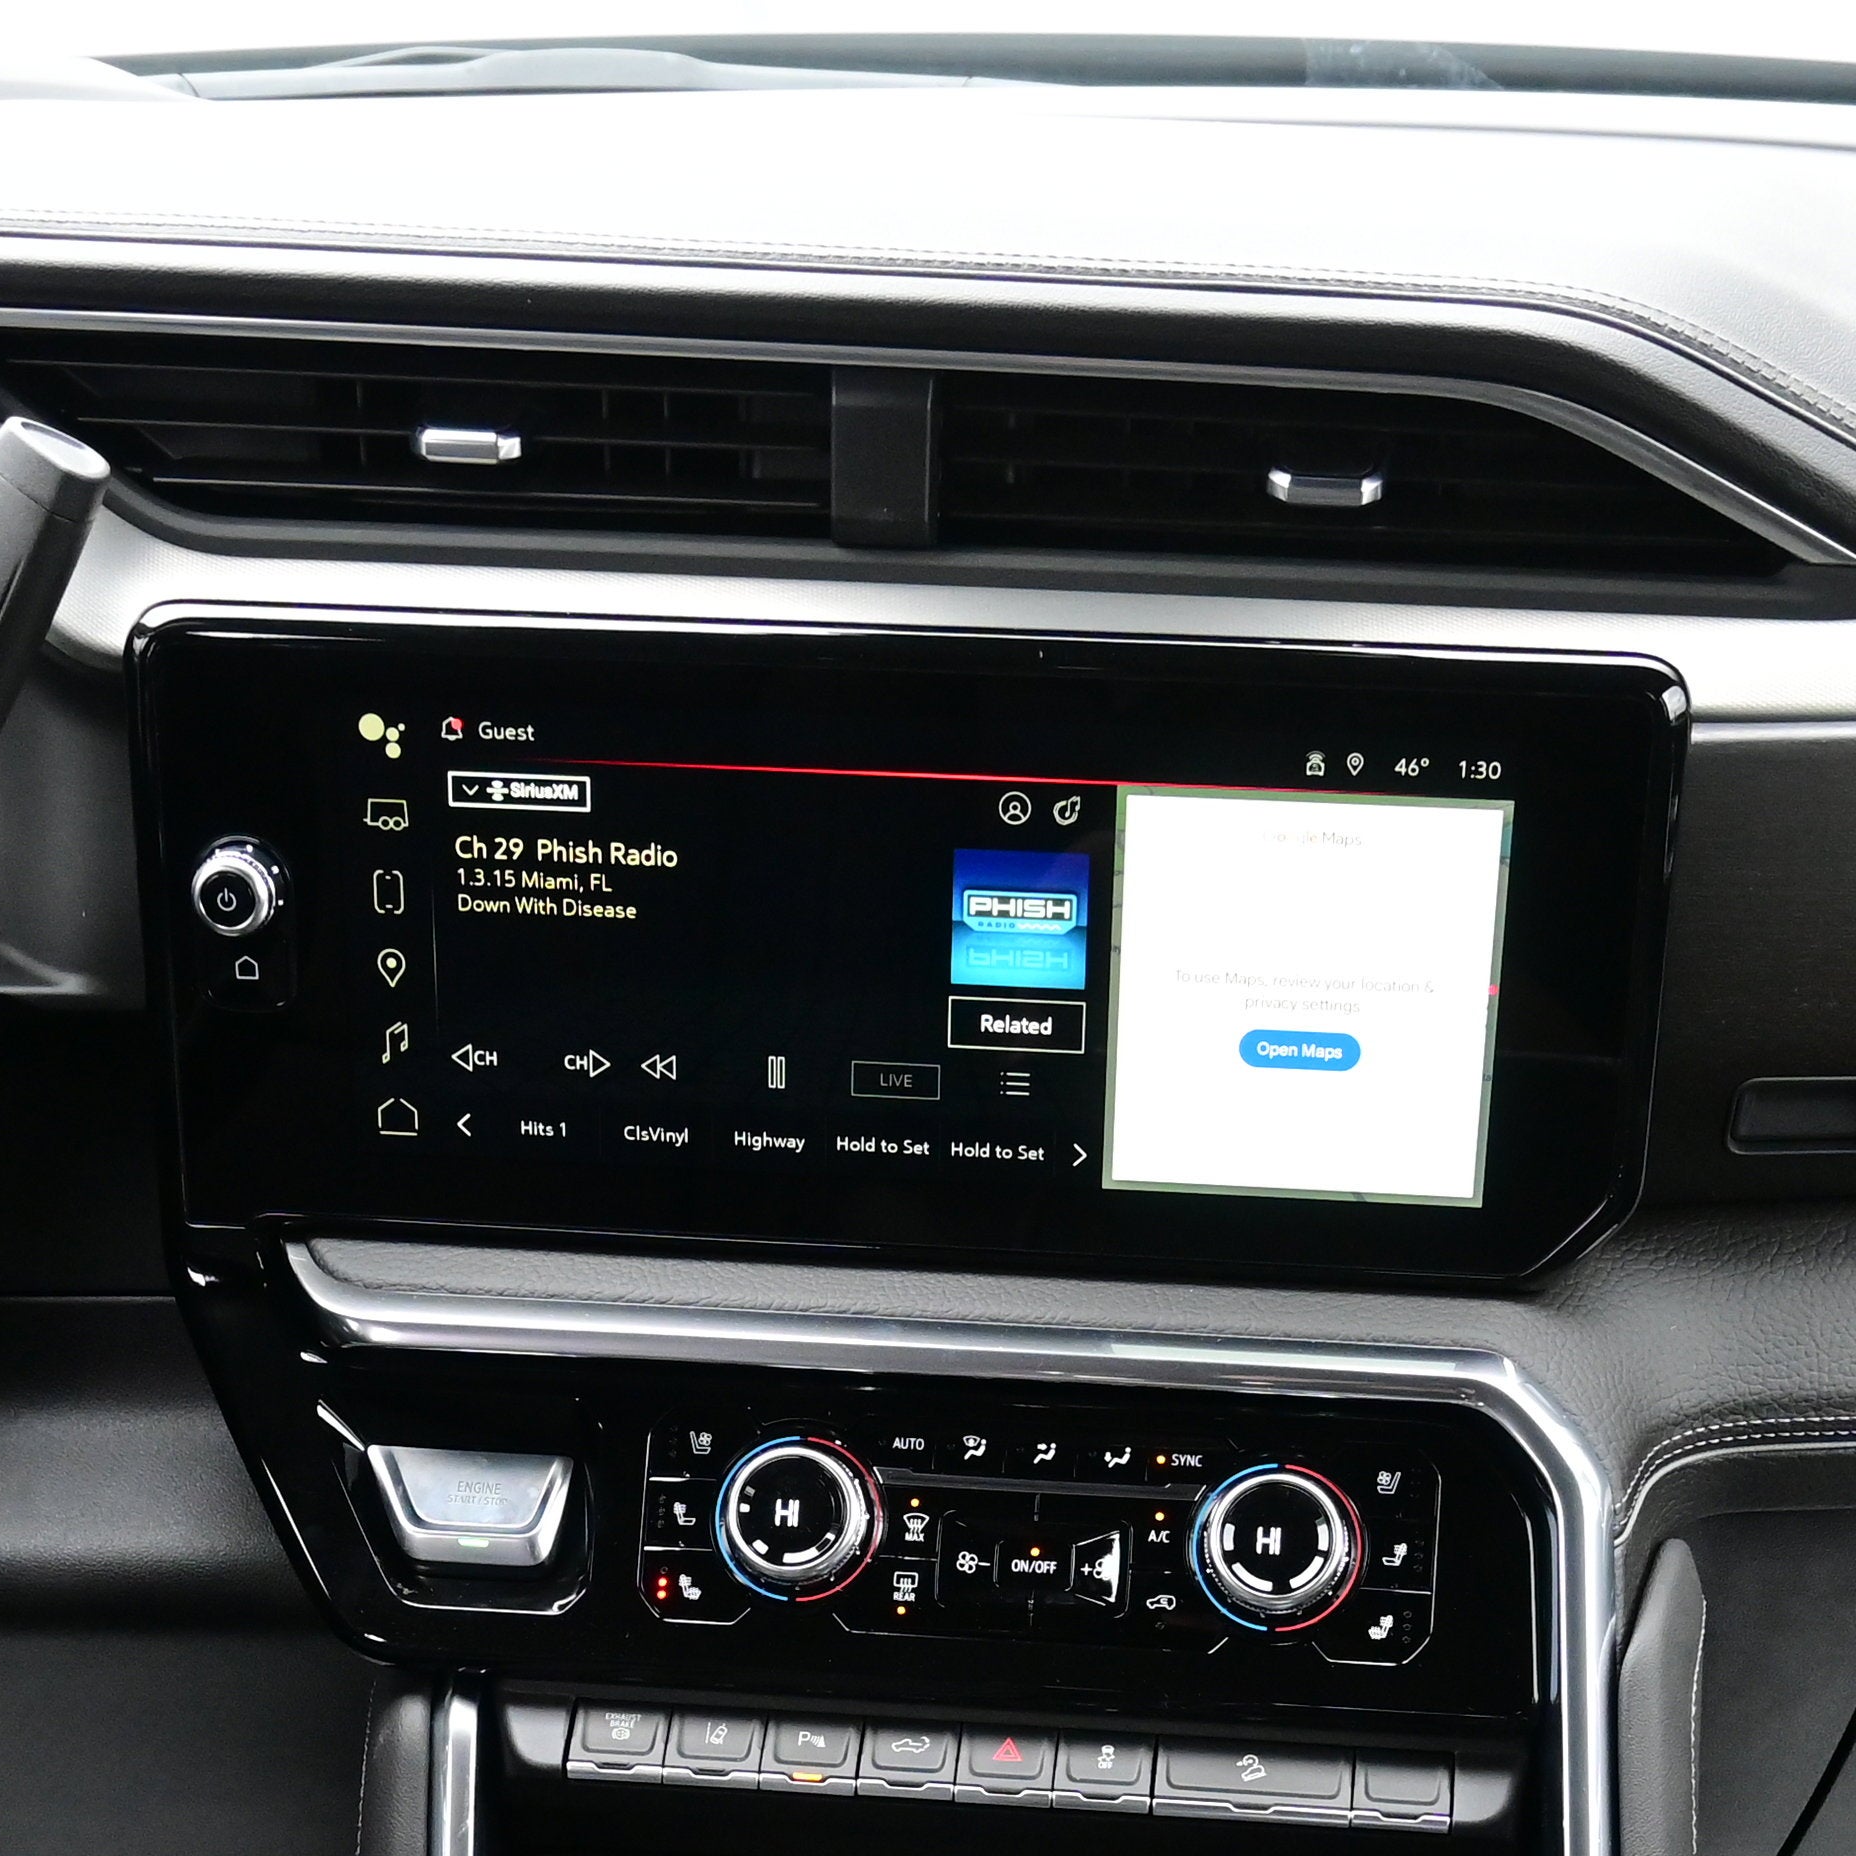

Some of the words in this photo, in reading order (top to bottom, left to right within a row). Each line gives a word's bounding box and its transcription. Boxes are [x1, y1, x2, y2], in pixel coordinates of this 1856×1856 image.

[478, 720, 535, 742] Guest
[1394, 757, 1430, 776] 46°
[1458, 761, 1502, 779] 1:30
[510, 781, 579, 801] SiriusXM
[455, 834, 487, 860] Ch
[494, 837, 524, 860] 29
[537, 838, 603, 864] Phish
[610, 841, 678, 868] Radio
[457, 868, 516, 887] 1.3.15
[521, 870, 584, 893] Miami,
[590, 873, 613, 892] FL
[457, 893, 511, 914] Down
[515, 896, 557, 916] With
[562, 898, 637, 919] Disease
[969, 896, 1071, 920] PHISH
[979, 1014, 1053, 1036] Related
[474, 1049, 498, 1067] CH
[1256, 1041, 1298, 1058] Open
[1301, 1043, 1343, 1062] Maps
[563, 1054, 588, 1071] CH
[879, 1072, 913, 1088] LIVE
[520, 1120, 554, 1137] Hits
[559, 1122, 567, 1137] 1
[623, 1125, 689, 1147] ClsVinyl
[733, 1131, 805, 1153] Highway
[836, 1136, 876, 1153] Hold
[880, 1138, 898, 1155] to
[903, 1139, 930, 1156] Set
[950, 1142, 990, 1159] Hold
[995, 1144, 1013, 1160] to
[1018, 1145, 1045, 1162] Set
[892, 1437, 925, 1451] AUTO
[1170, 1454, 1203, 1467] SYNC
[457, 1480, 502, 1495] ENGINE
[775, 1499, 799, 1528] HI
[1148, 1531, 1170, 1543] A/C
[1256, 1526, 1281, 1555] HI
[1011, 1559, 1057, 1574] ON/OFF
